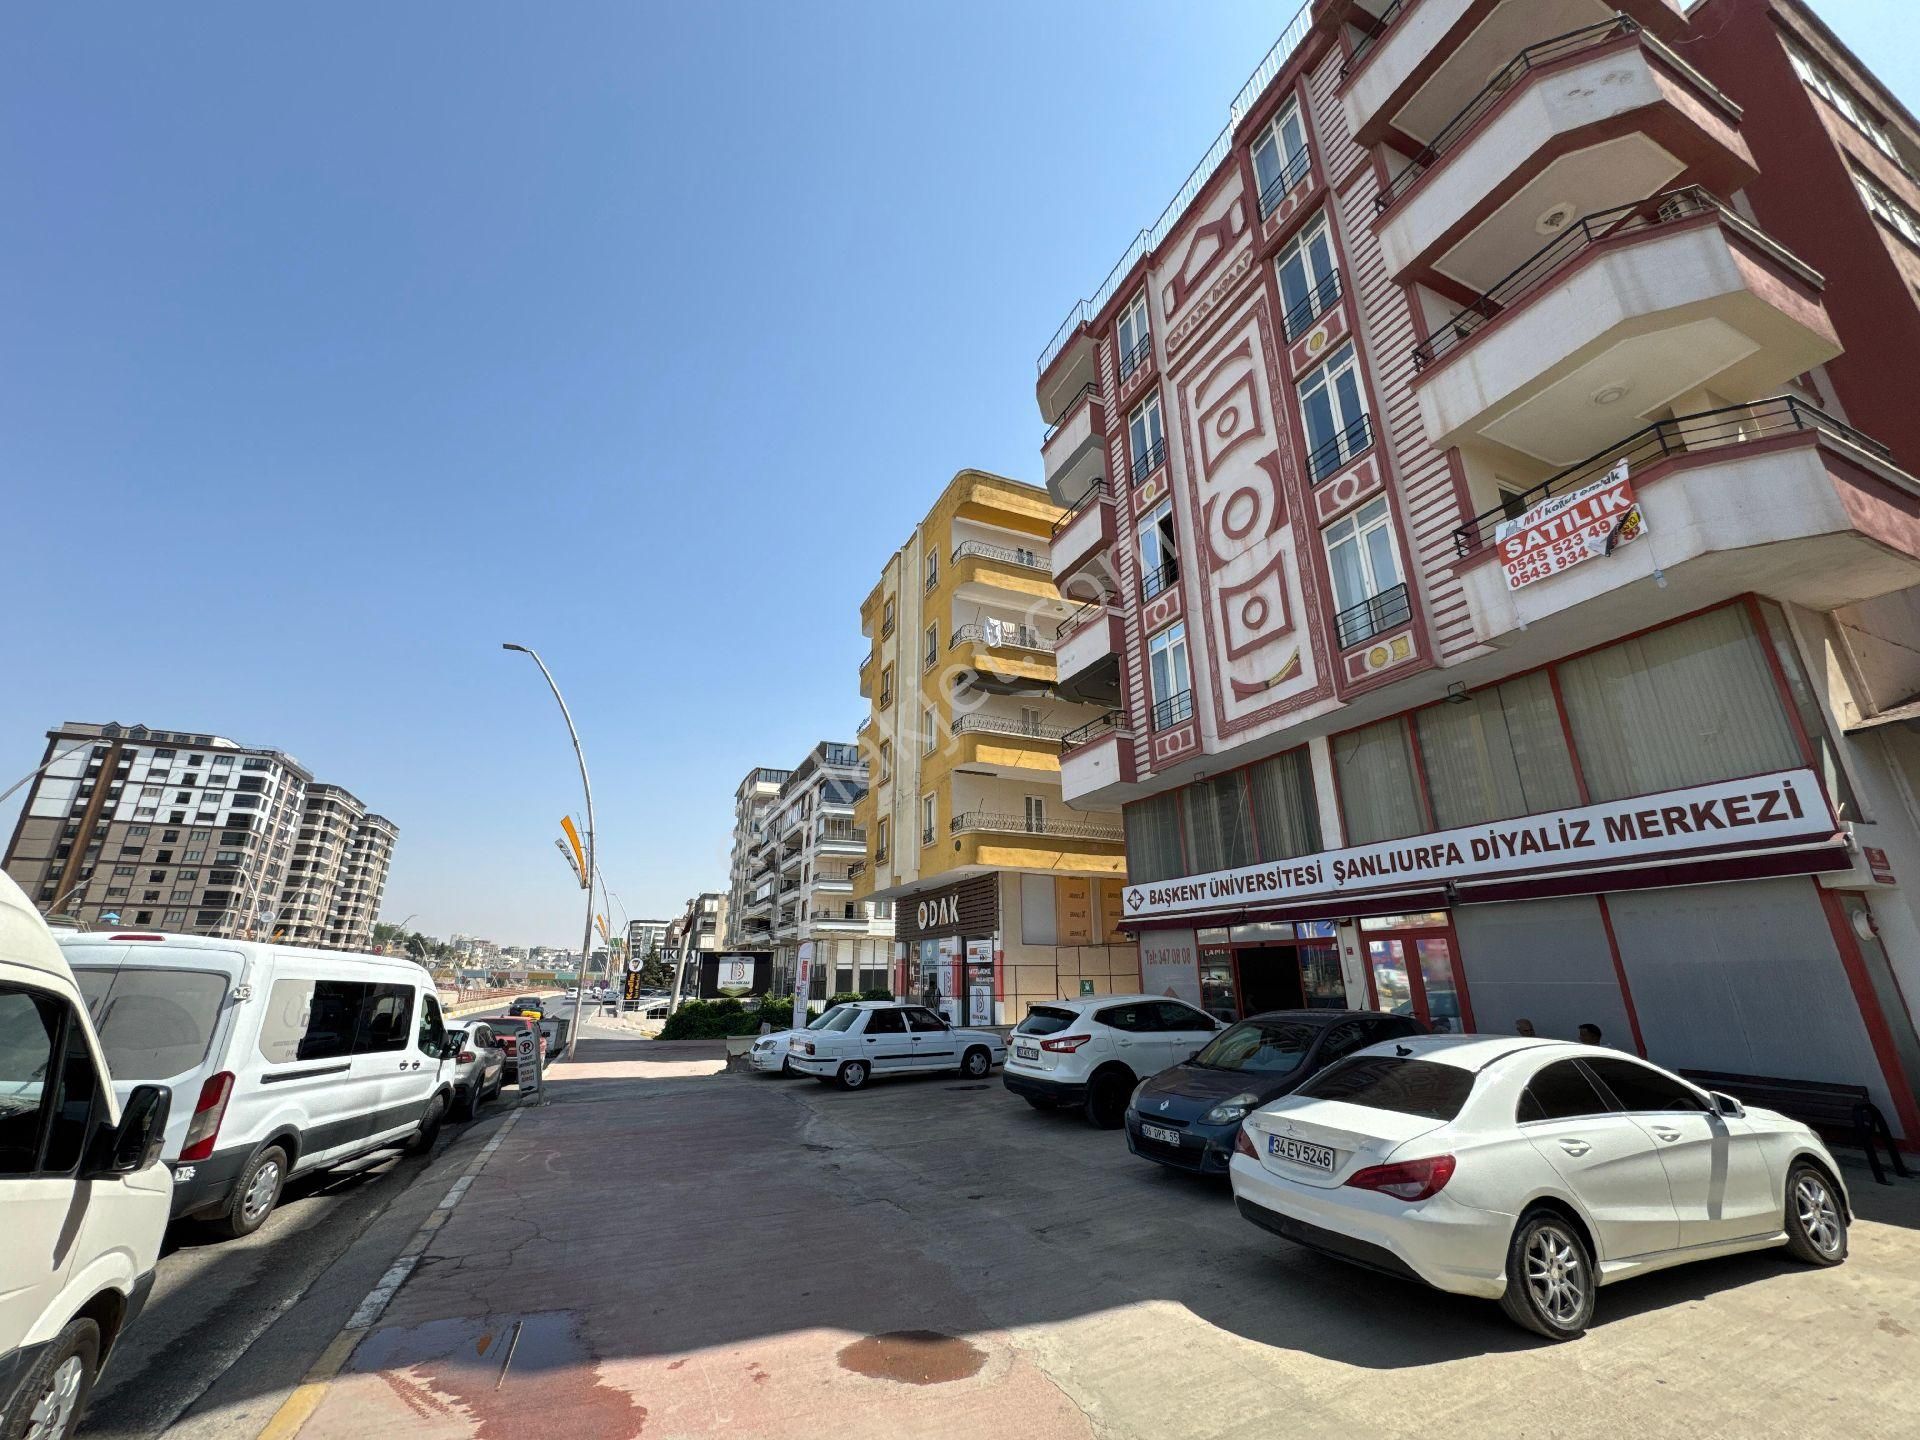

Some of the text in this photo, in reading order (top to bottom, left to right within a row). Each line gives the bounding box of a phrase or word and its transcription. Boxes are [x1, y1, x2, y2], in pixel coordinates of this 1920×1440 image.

[1505, 486, 1630, 559] SATILIK
[1523, 505, 1543, 527] MY
[1508, 551, 1548, 576] 0545
[1552, 533, 1585, 556] 523
[1588, 520, 1612, 538] 49
[1510, 546, 1589, 588] 0543 934
[1149, 780, 1805, 909] BAŞKENT ÜNİVERSİTESİ ŞANLIURFA DİYALİZ MERKEZİ
[917, 894, 960, 930] ODAK
[1158, 949, 1171, 965] 347
[1171, 949, 1181, 965] 08
[1181, 948, 1191, 964] 08
